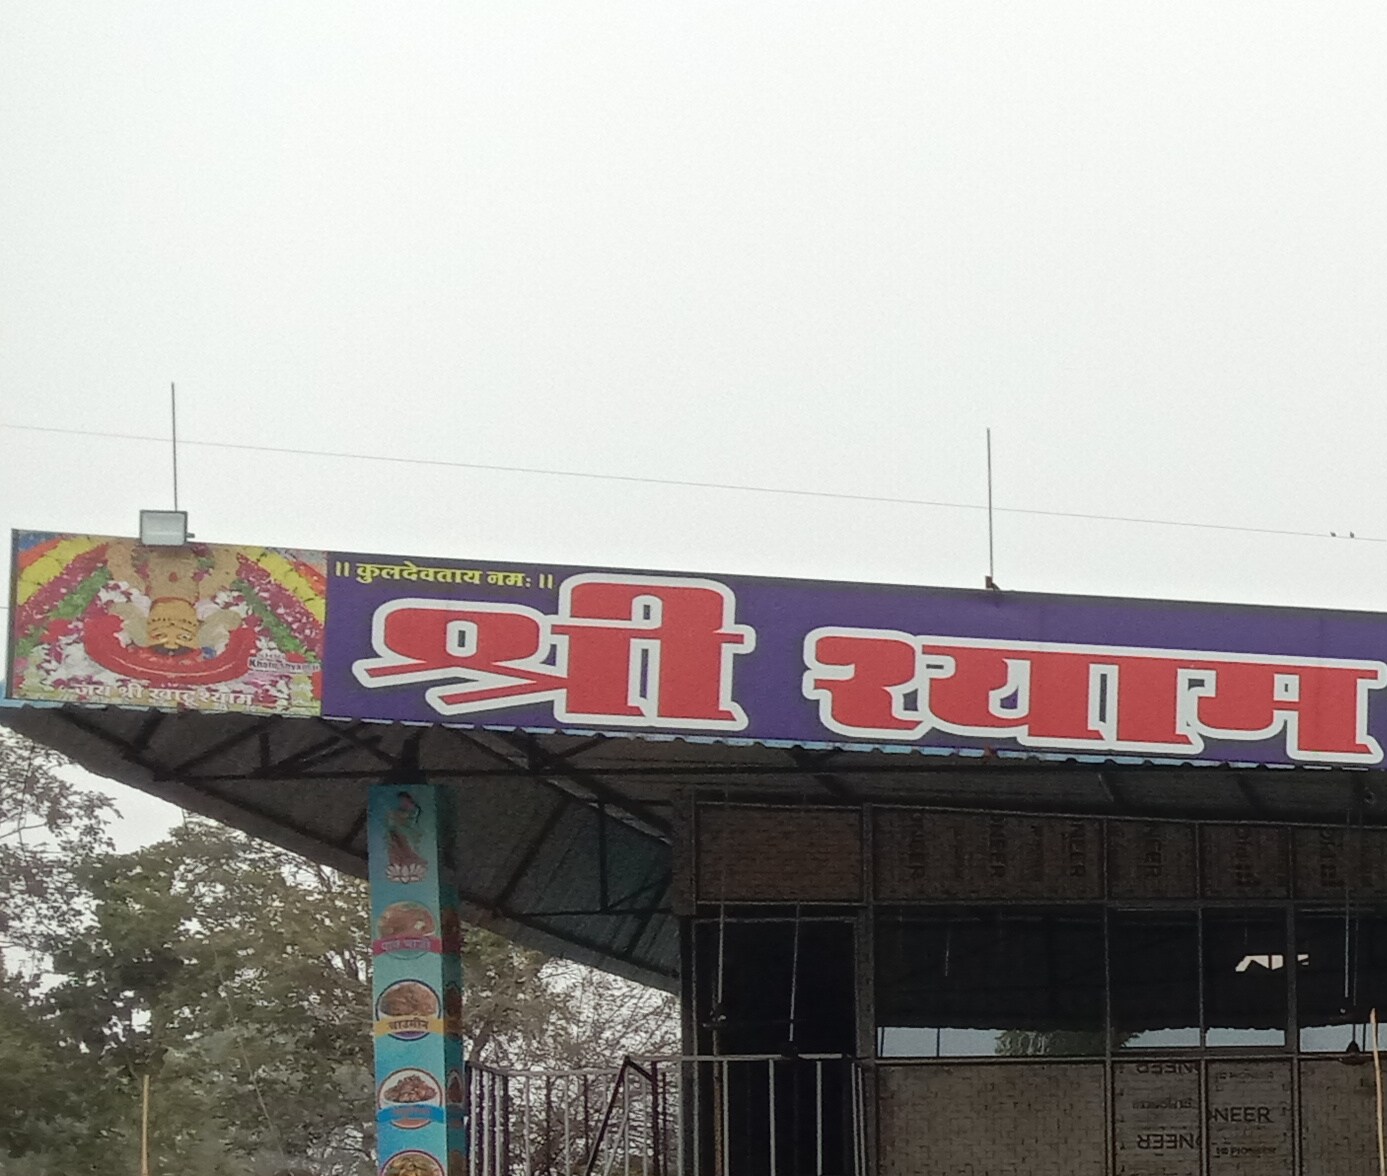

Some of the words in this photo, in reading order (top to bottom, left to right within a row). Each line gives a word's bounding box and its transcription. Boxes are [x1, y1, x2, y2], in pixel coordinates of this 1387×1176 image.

[356, 560, 482, 585] कुलदेवताय
[353, 573, 755, 730] श्री
[804, 624, 1387, 763] श्याम
